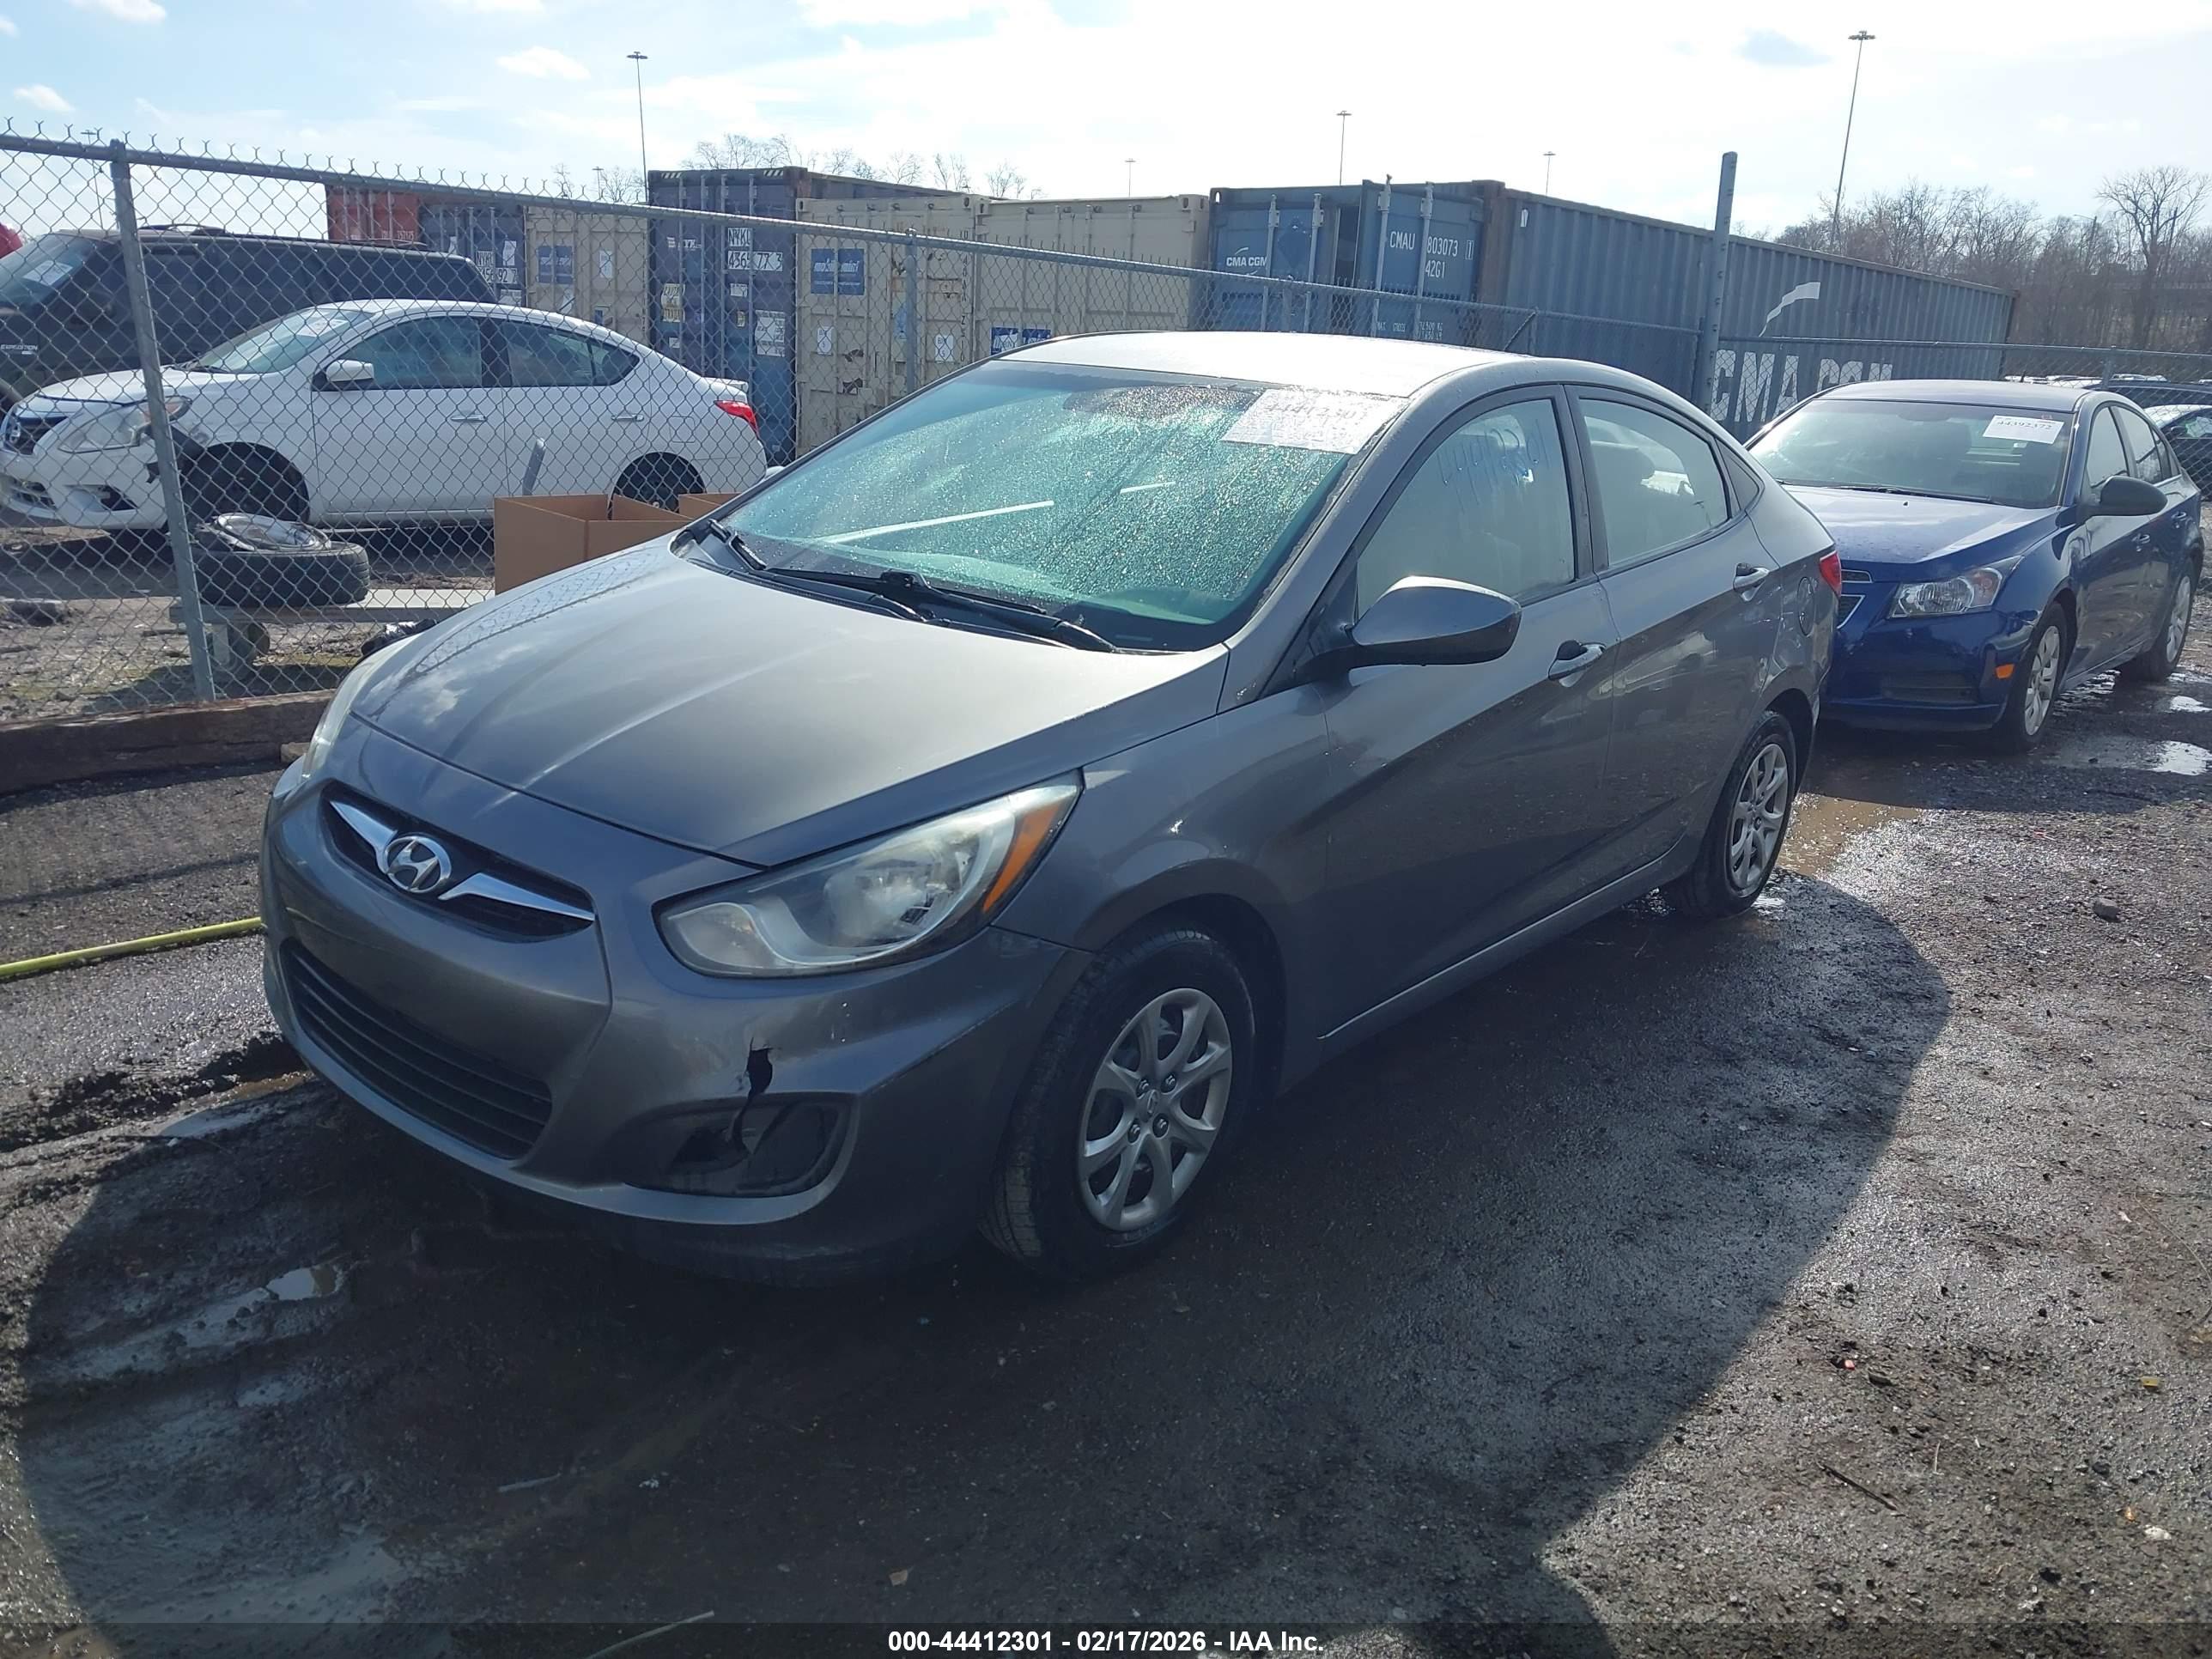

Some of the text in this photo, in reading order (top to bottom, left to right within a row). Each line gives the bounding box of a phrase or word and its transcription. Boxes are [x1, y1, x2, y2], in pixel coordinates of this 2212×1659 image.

[1390, 231, 1416, 250] CMAU
[1427, 236, 1459, 257] 803073
[1226, 257, 1247, 267] CMA
[1425, 260, 1445, 278] 42G1
[1710, 349, 1800, 422] CMA
